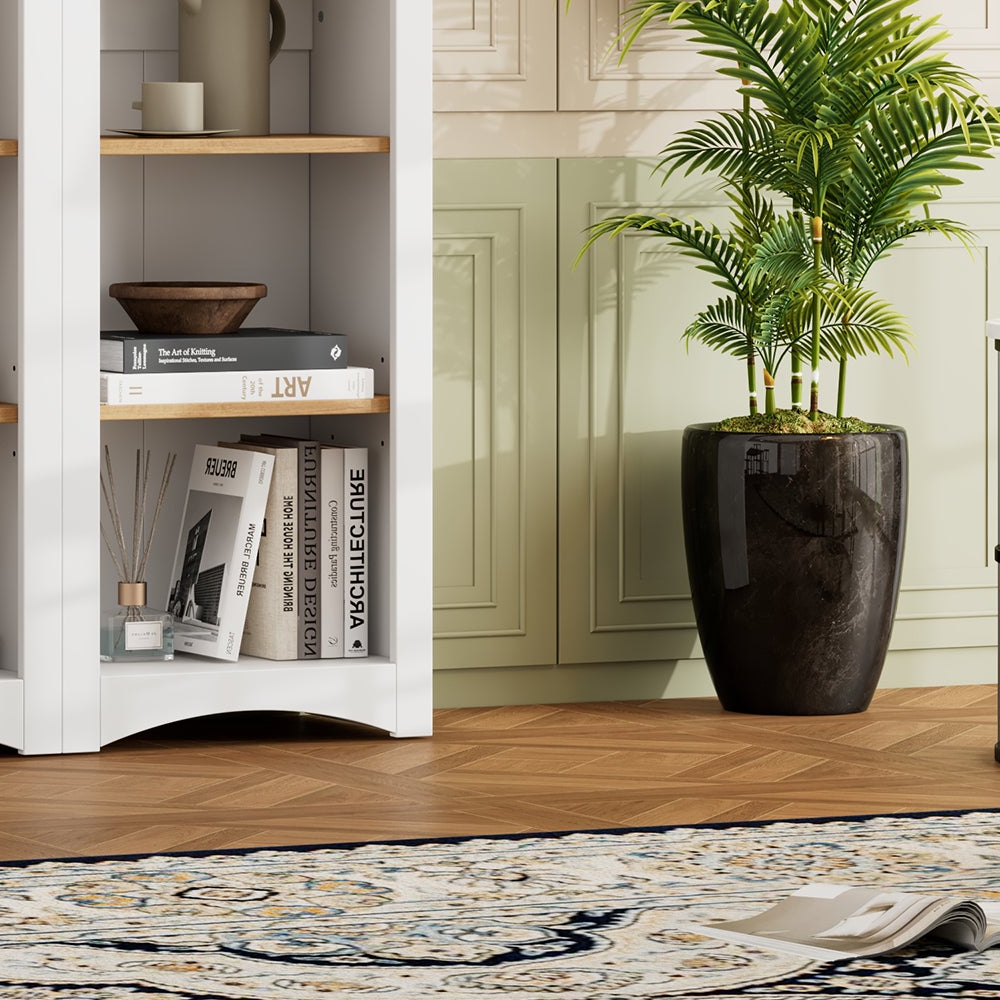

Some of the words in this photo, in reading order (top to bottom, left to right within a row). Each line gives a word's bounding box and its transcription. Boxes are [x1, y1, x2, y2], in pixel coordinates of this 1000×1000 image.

[158, 348, 171, 357] The
[171, 348, 183, 356] Art
[182, 348, 190, 356] of
[190, 347, 216, 358] Knitting
[271, 375, 312, 398] ART
